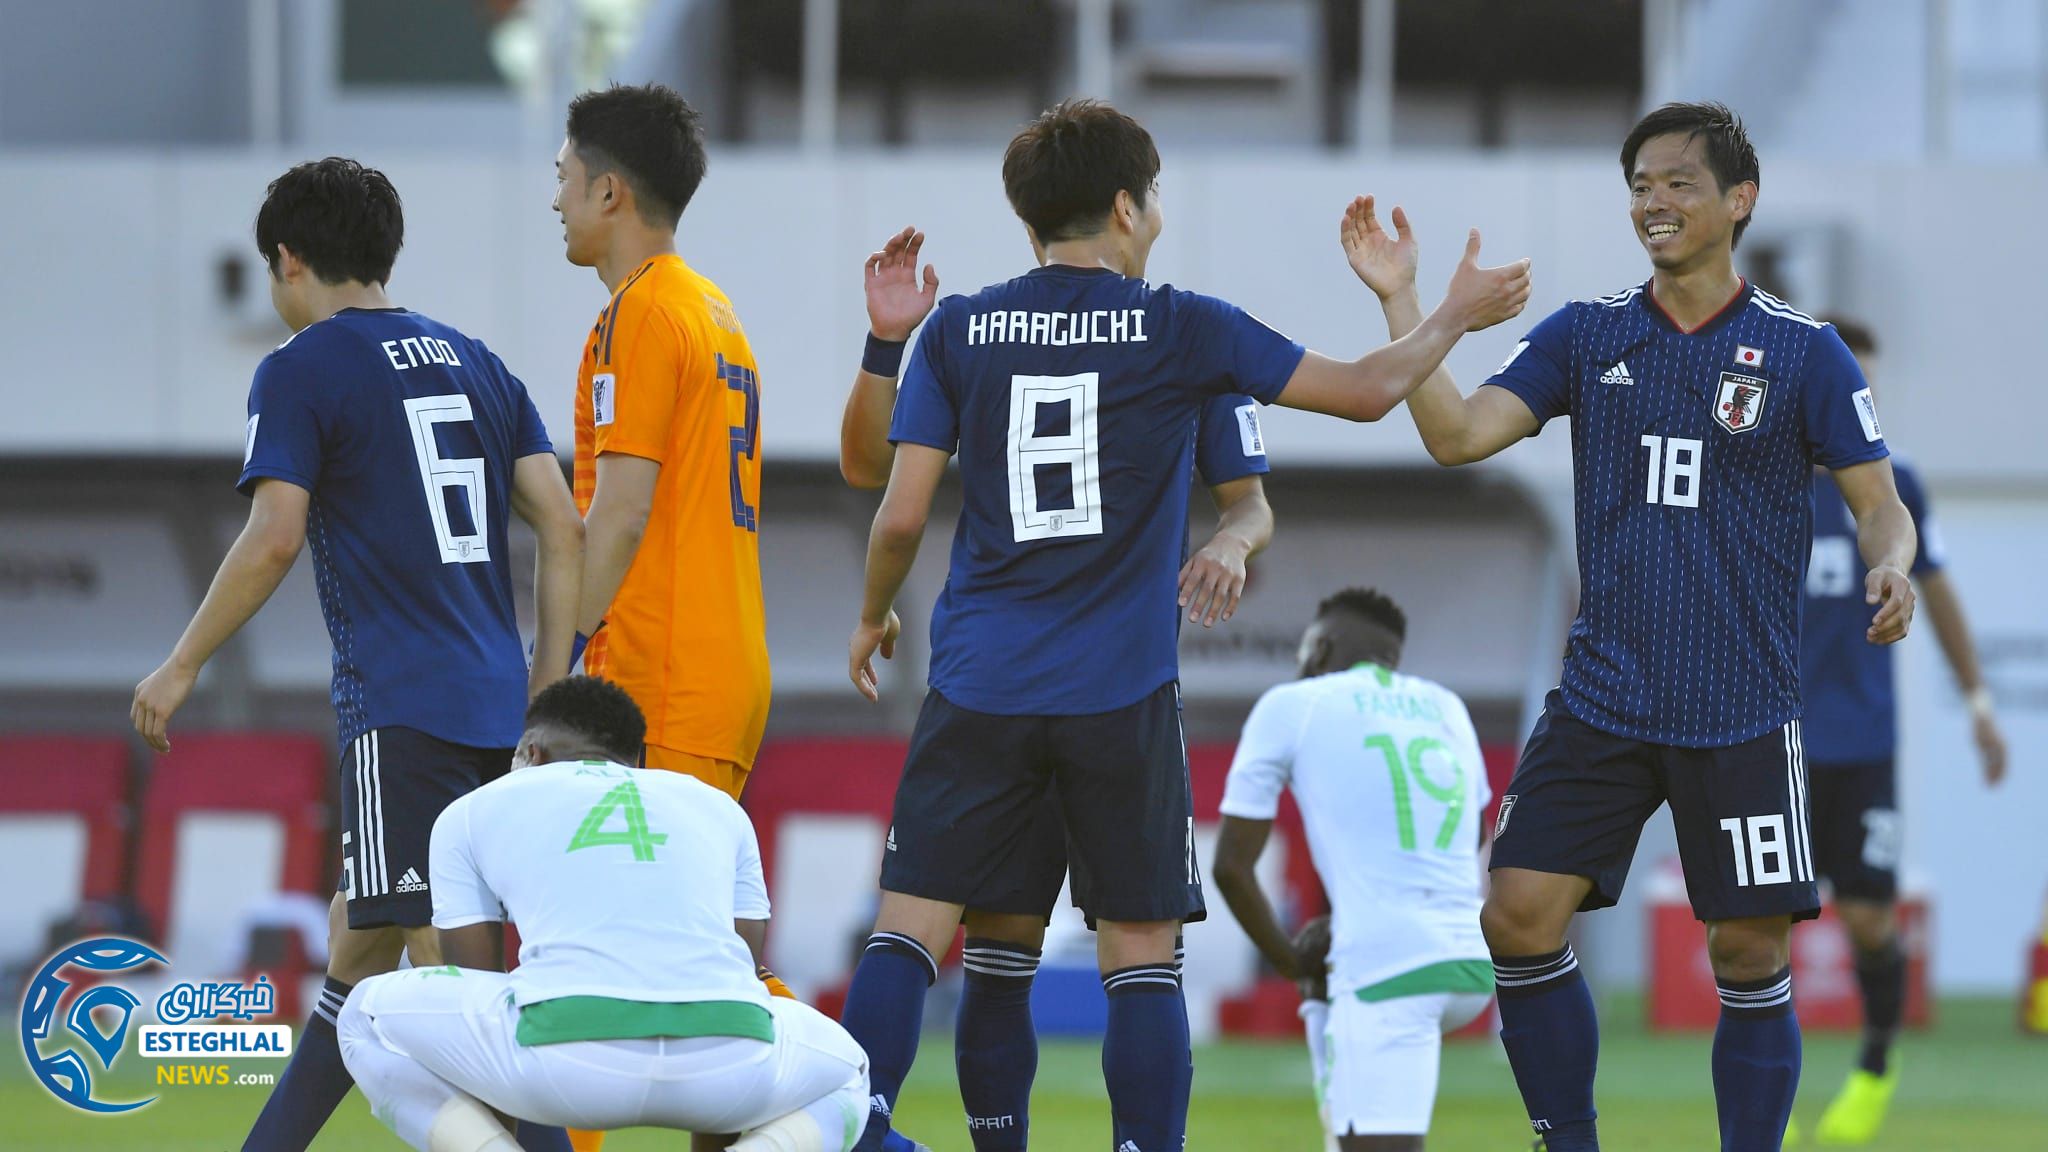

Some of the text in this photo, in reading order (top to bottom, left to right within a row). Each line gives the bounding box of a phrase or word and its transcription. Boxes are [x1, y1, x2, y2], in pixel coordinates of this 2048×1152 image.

[381, 336, 463, 370] ENDO
[967, 309, 1148, 346] HARAGUCHI
[1600, 376, 1634, 386] adidas
[1732, 376, 1758, 386] JAPAN
[403, 393, 491, 564] 6
[1006, 371, 1104, 543] 8
[1640, 434, 1704, 508] 18
[565, 779, 669, 862] 4
[1363, 733, 1467, 853] 19
[1719, 813, 1792, 887] 18
[395, 882, 429, 893] adidas
